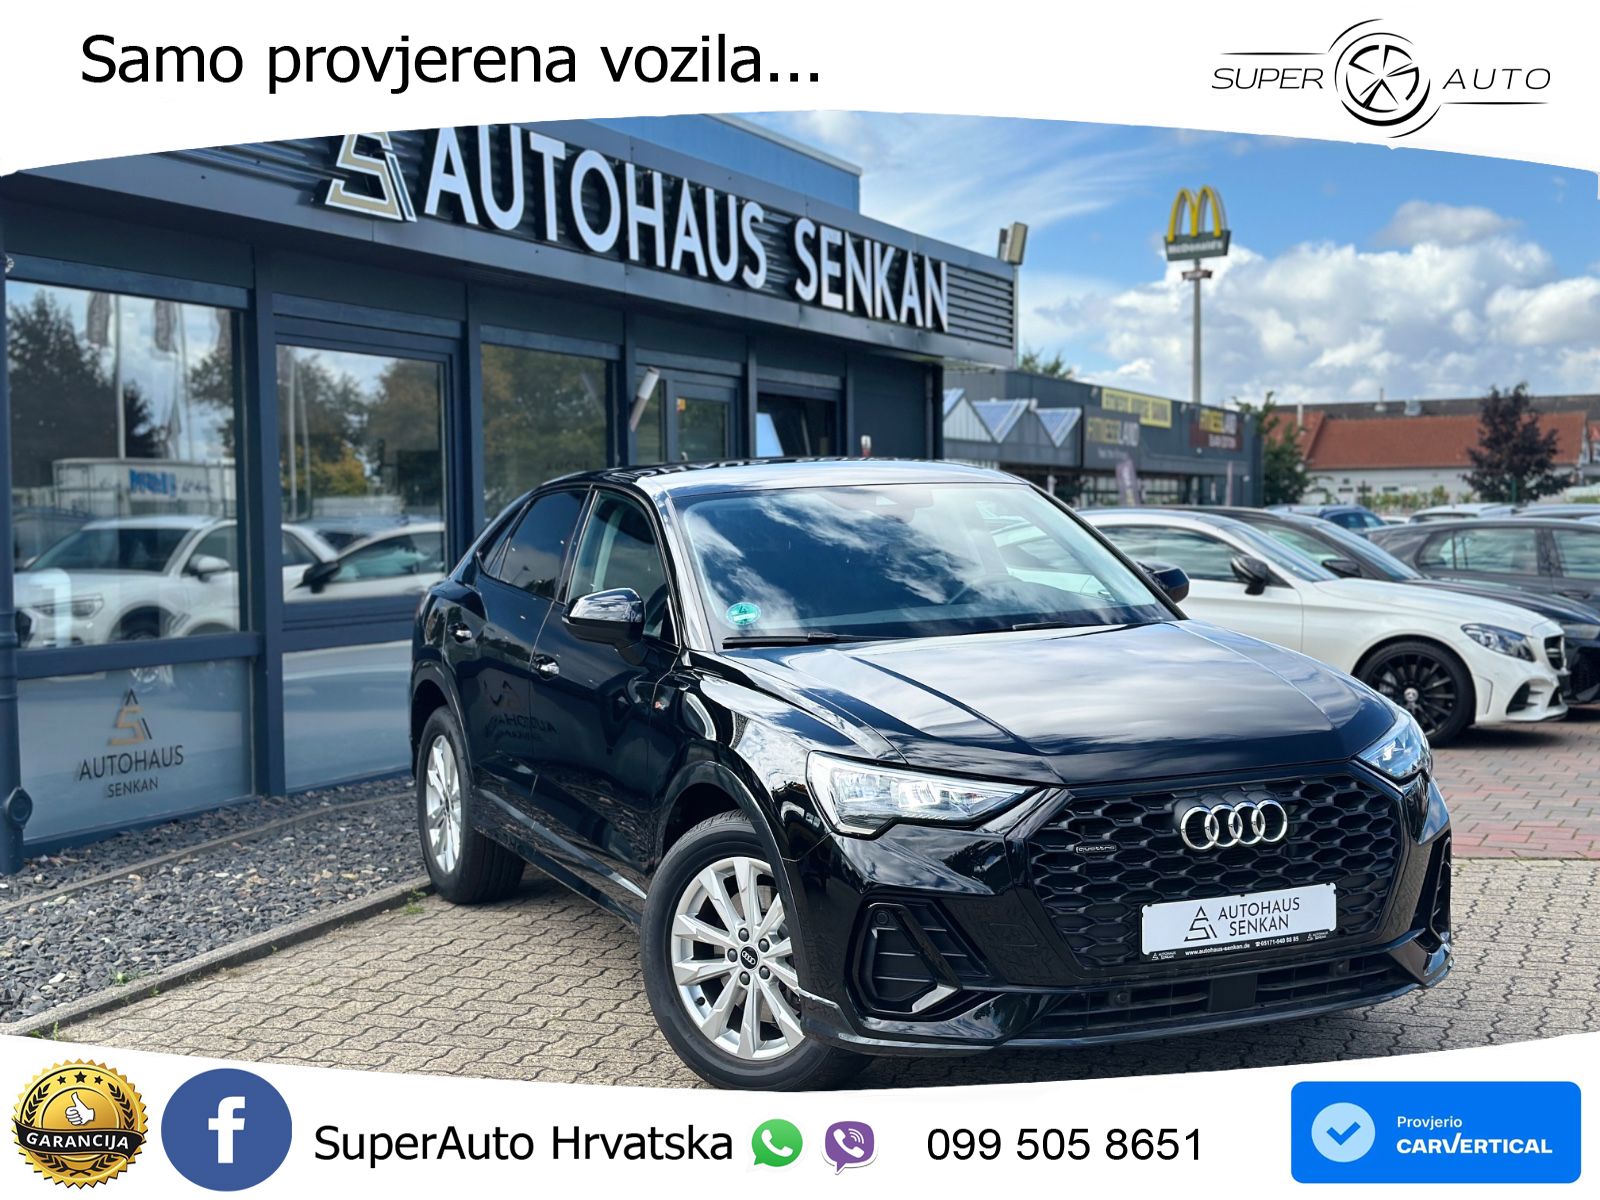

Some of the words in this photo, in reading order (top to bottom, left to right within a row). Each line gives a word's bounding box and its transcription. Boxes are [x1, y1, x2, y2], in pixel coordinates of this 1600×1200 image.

[424, 124, 767, 290] AUTOHAUS
[795, 217, 949, 333] SENKAN
[78, 744, 185, 782] AUTOHAUS
[106, 776, 159, 799] SENKAN
[1217, 896, 1301, 921] AUTOHAUS
[1229, 913, 1290, 937] SENKAN
[1185, 943, 1250, 957] www.autohaus-senkan.de
